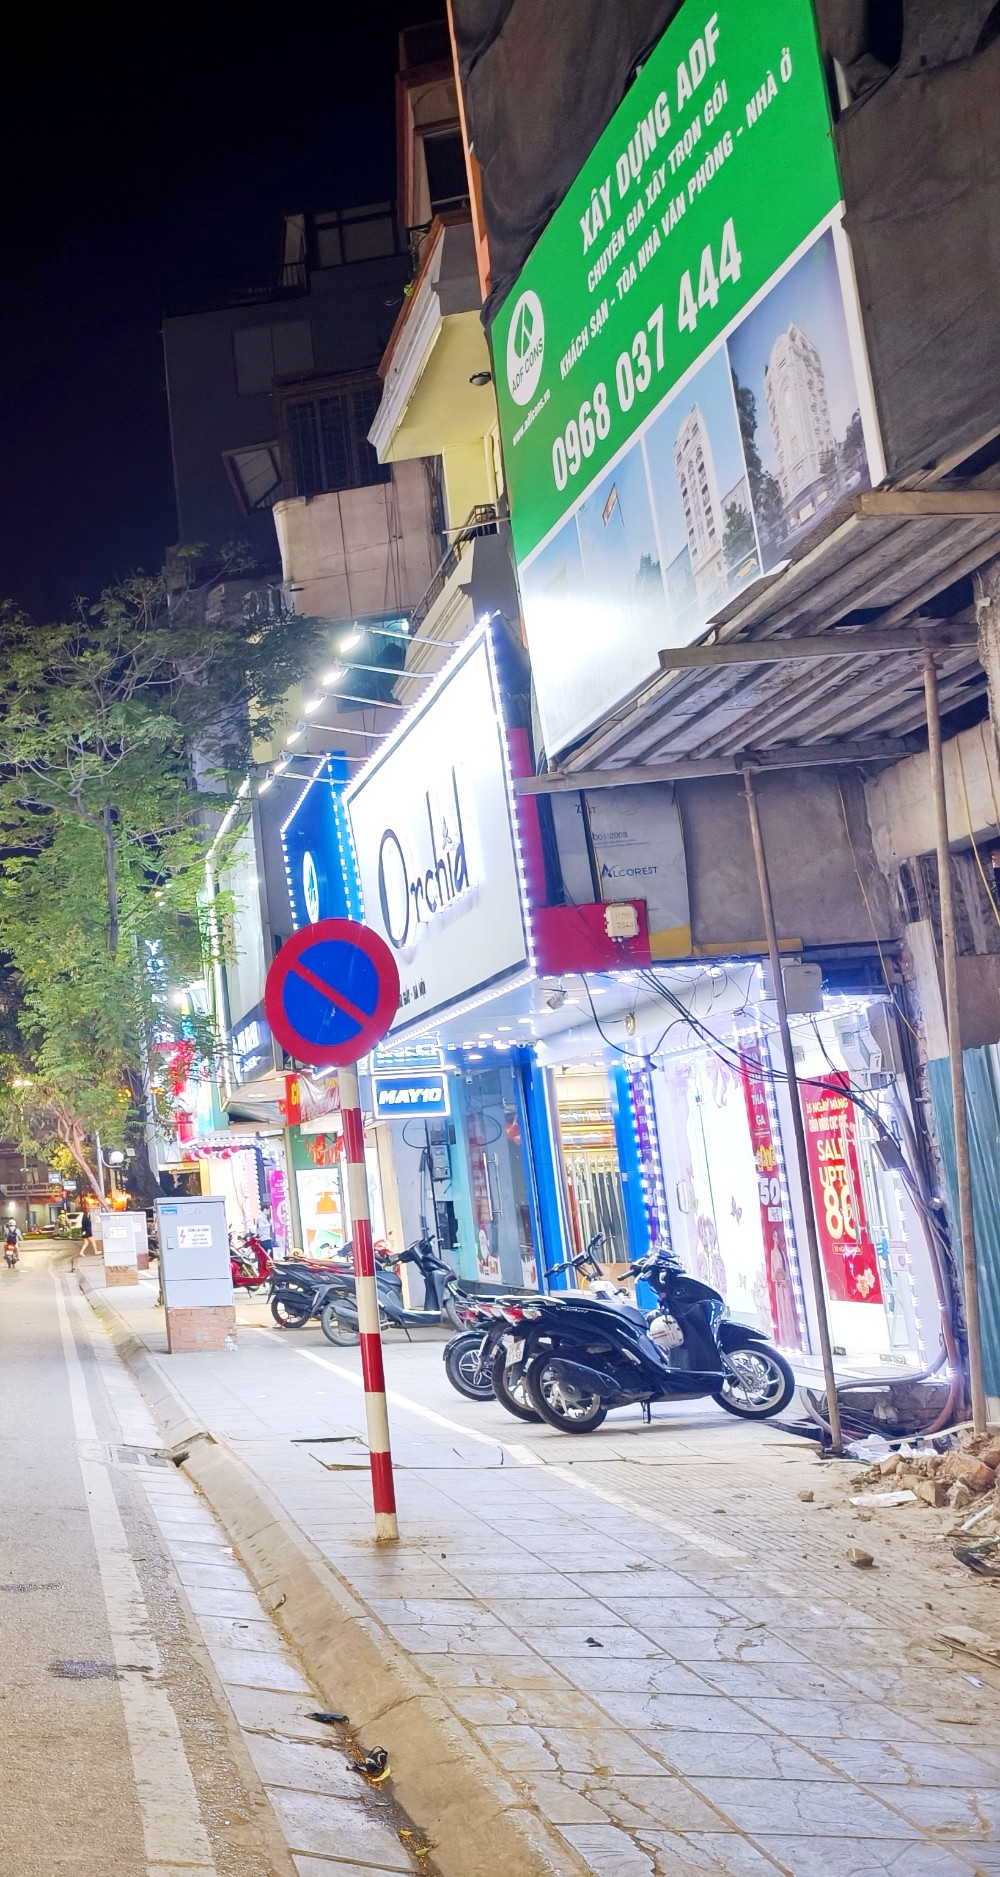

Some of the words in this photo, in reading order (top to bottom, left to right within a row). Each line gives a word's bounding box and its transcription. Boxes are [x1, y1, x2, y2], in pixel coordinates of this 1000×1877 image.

[559, 326, 590, 381] KHÁCH
[590, 298, 609, 335] SẠN
[615, 261, 638, 300] TÒA
[637, 224, 661, 272] NHÀ
[661, 191, 686, 238] VĂN
[687, 130, 734, 205] PHÒNG
[745, 70, 778, 129] NHÀ
[780, 47, 792, 83] Ở
[579, 175, 611, 256] XÂY
[615, 91, 671, 199] DỰNG
[676, 11, 720, 114] ADF
[587, 225, 626, 293] CHUYÊN
[626, 199, 645, 236] GIA
[645, 163, 666, 210] XÂY
[668, 115, 702, 175] TRỌN
[703, 79, 728, 127] GÓI
[511, 366, 524, 394] ADF
[524, 337, 544, 374] CONS
[552, 382, 611, 492] 0968
[615, 303, 665, 412] 037
[678, 216, 742, 333] 444
[378, 764, 472, 950] Orchid
[601, 862, 659, 878] ALCOREST
[379, 1087, 442, 1105] MAY10
[759, 1177, 781, 1206] 50
